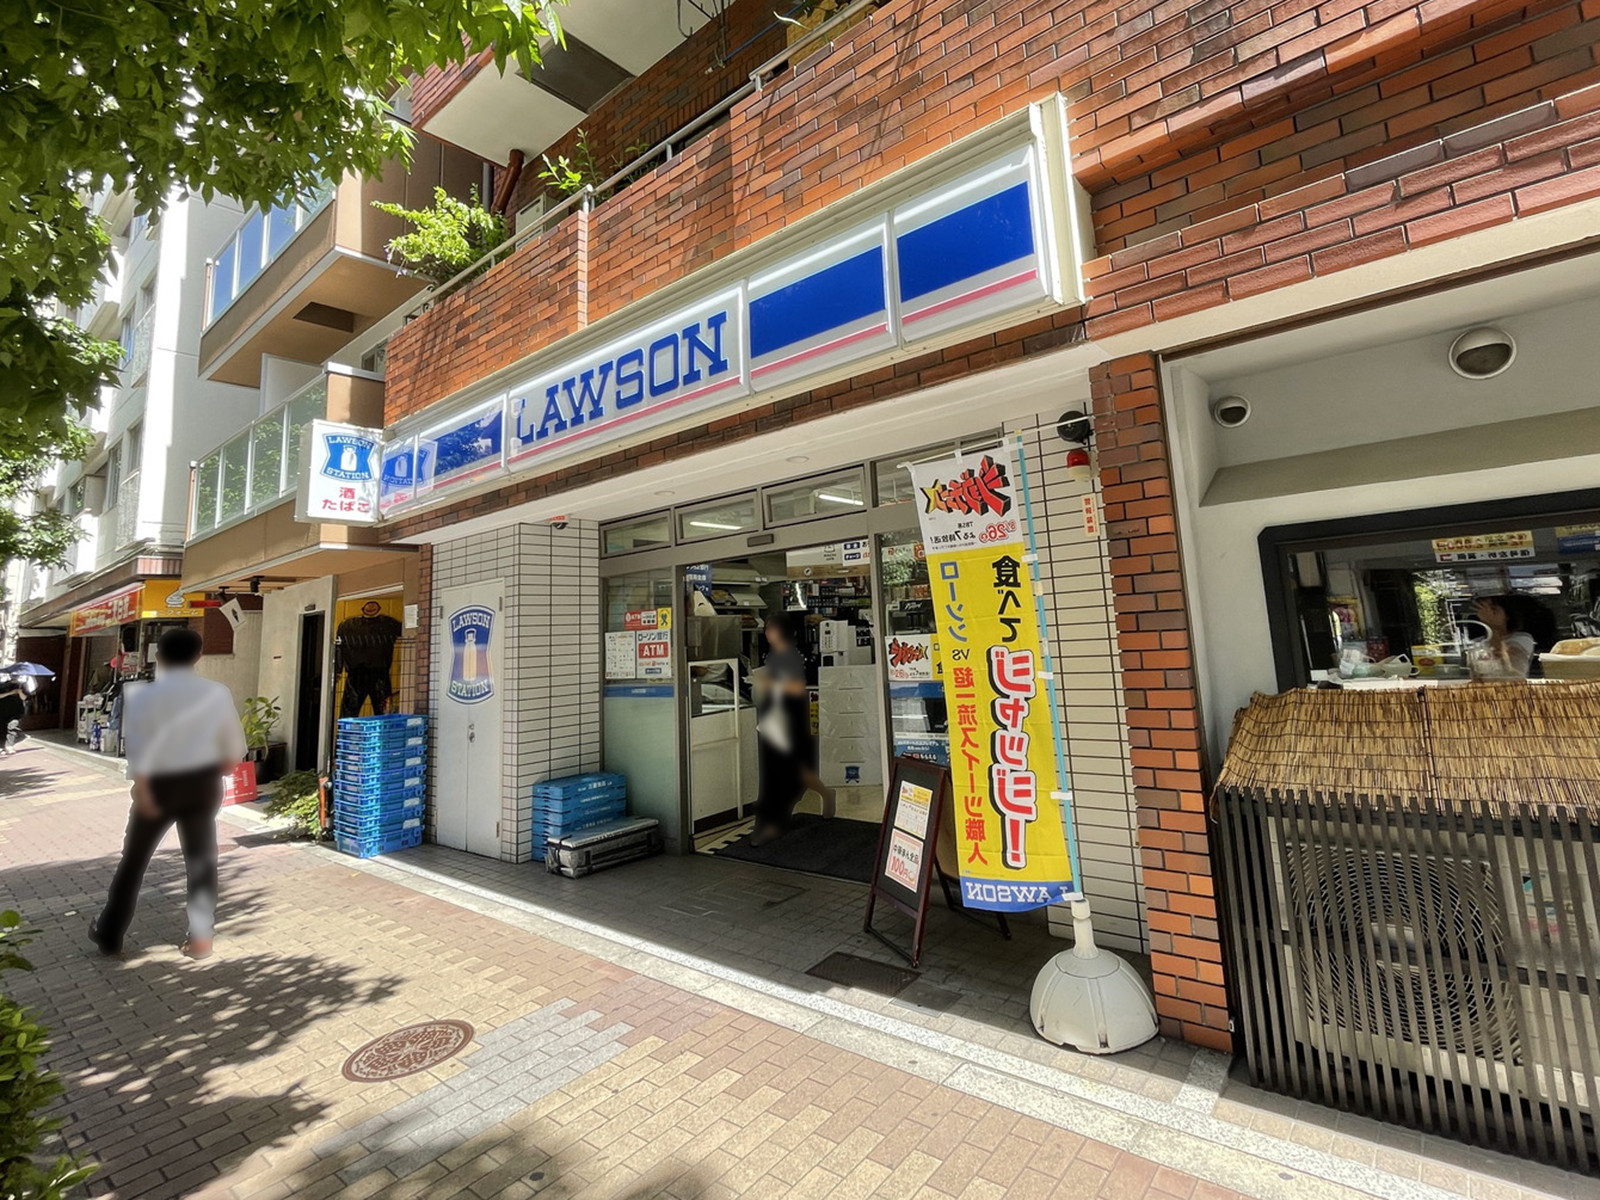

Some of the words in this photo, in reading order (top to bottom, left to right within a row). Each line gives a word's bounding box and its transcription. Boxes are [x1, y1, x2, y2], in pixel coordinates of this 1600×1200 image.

[516, 310, 728, 446] LAWSON
[327, 436, 373, 450] LAWSON
[326, 467, 370, 480] STATION
[339, 486, 356, 500] 酒
[322, 498, 371, 513] たばこ
[452, 612, 491, 633] LAWSON
[642, 644, 665, 657] ATM
[450, 678, 490, 698] STATION
